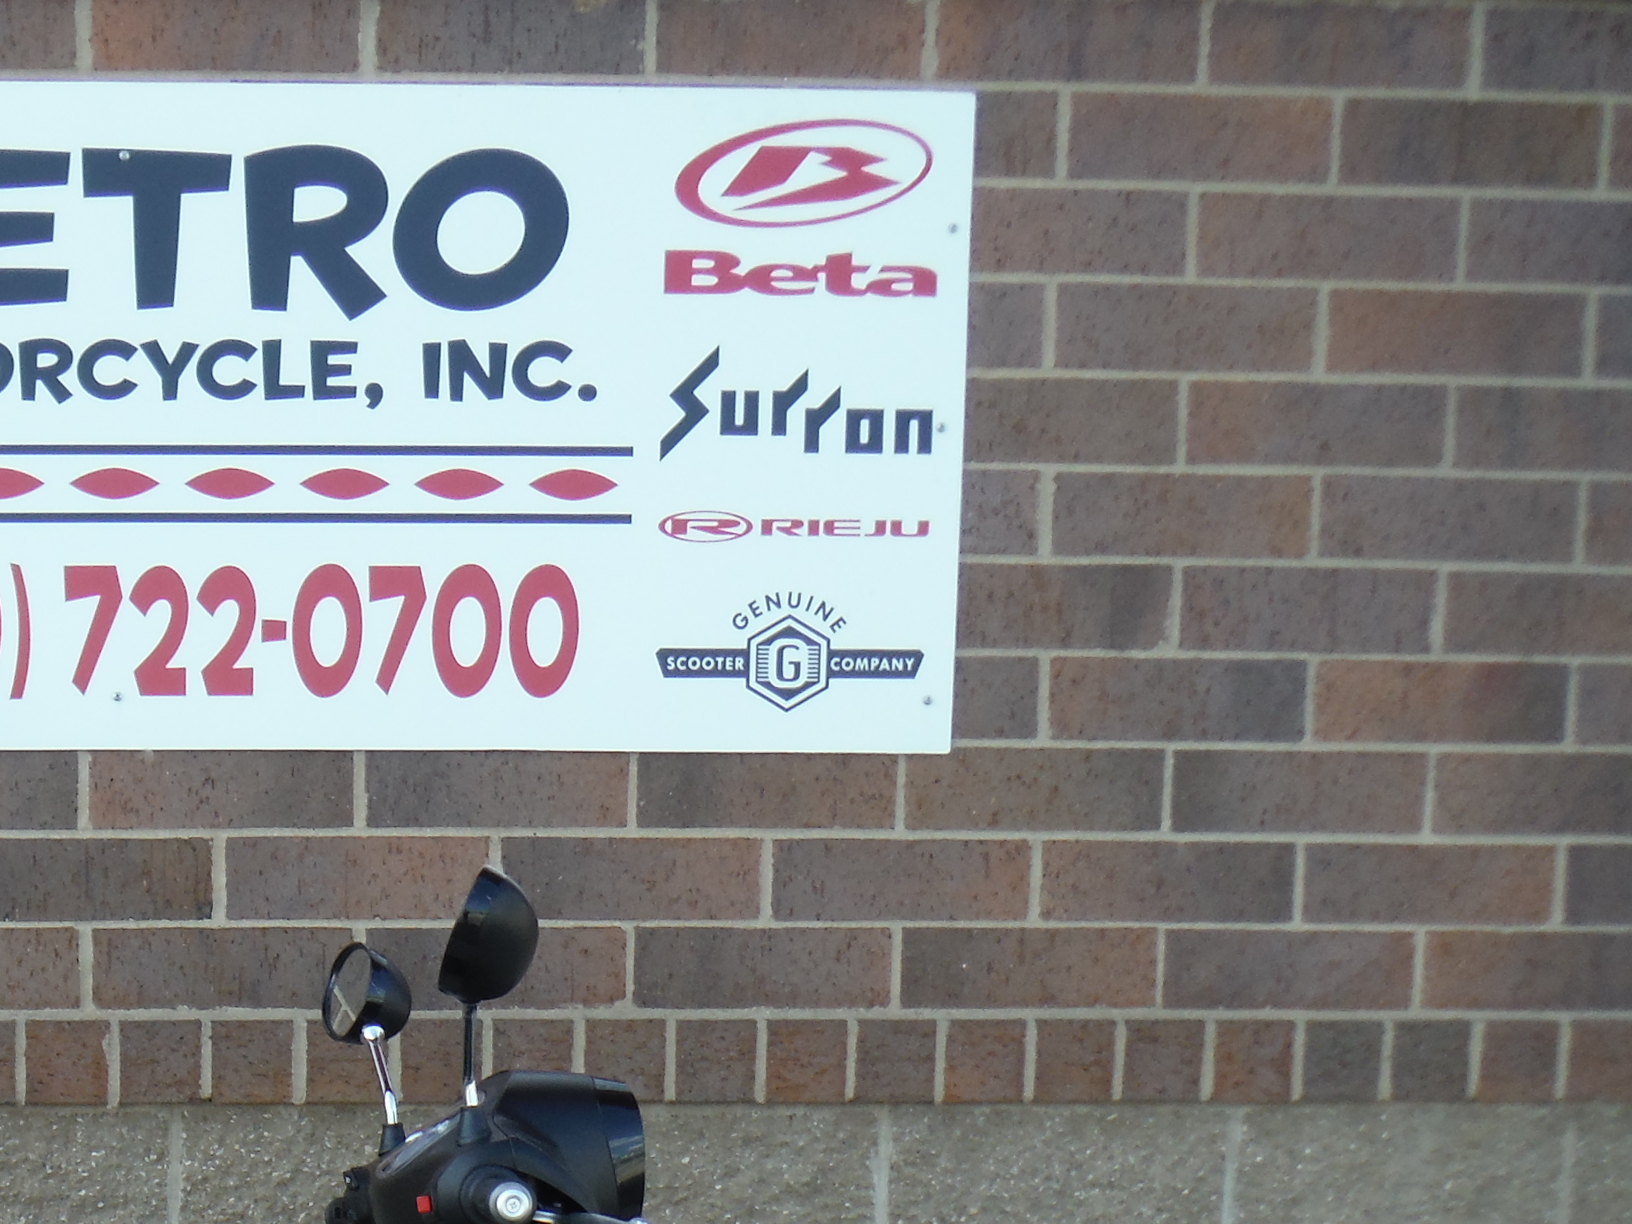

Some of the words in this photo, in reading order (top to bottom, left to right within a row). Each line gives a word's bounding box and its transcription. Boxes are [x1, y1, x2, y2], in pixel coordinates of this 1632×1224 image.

[664, 249, 938, 297] Beta
[422, 338, 599, 402] INC.
[659, 345, 934, 461] Surron
[760, 518, 930, 537] RIEJU
[64, 563, 580, 699] 722-0700
[731, 591, 847, 634] GENUINE
[666, 656, 745, 671] SCOOTER
[776, 644, 801, 682] G
[829, 656, 915, 672] COMPANY
